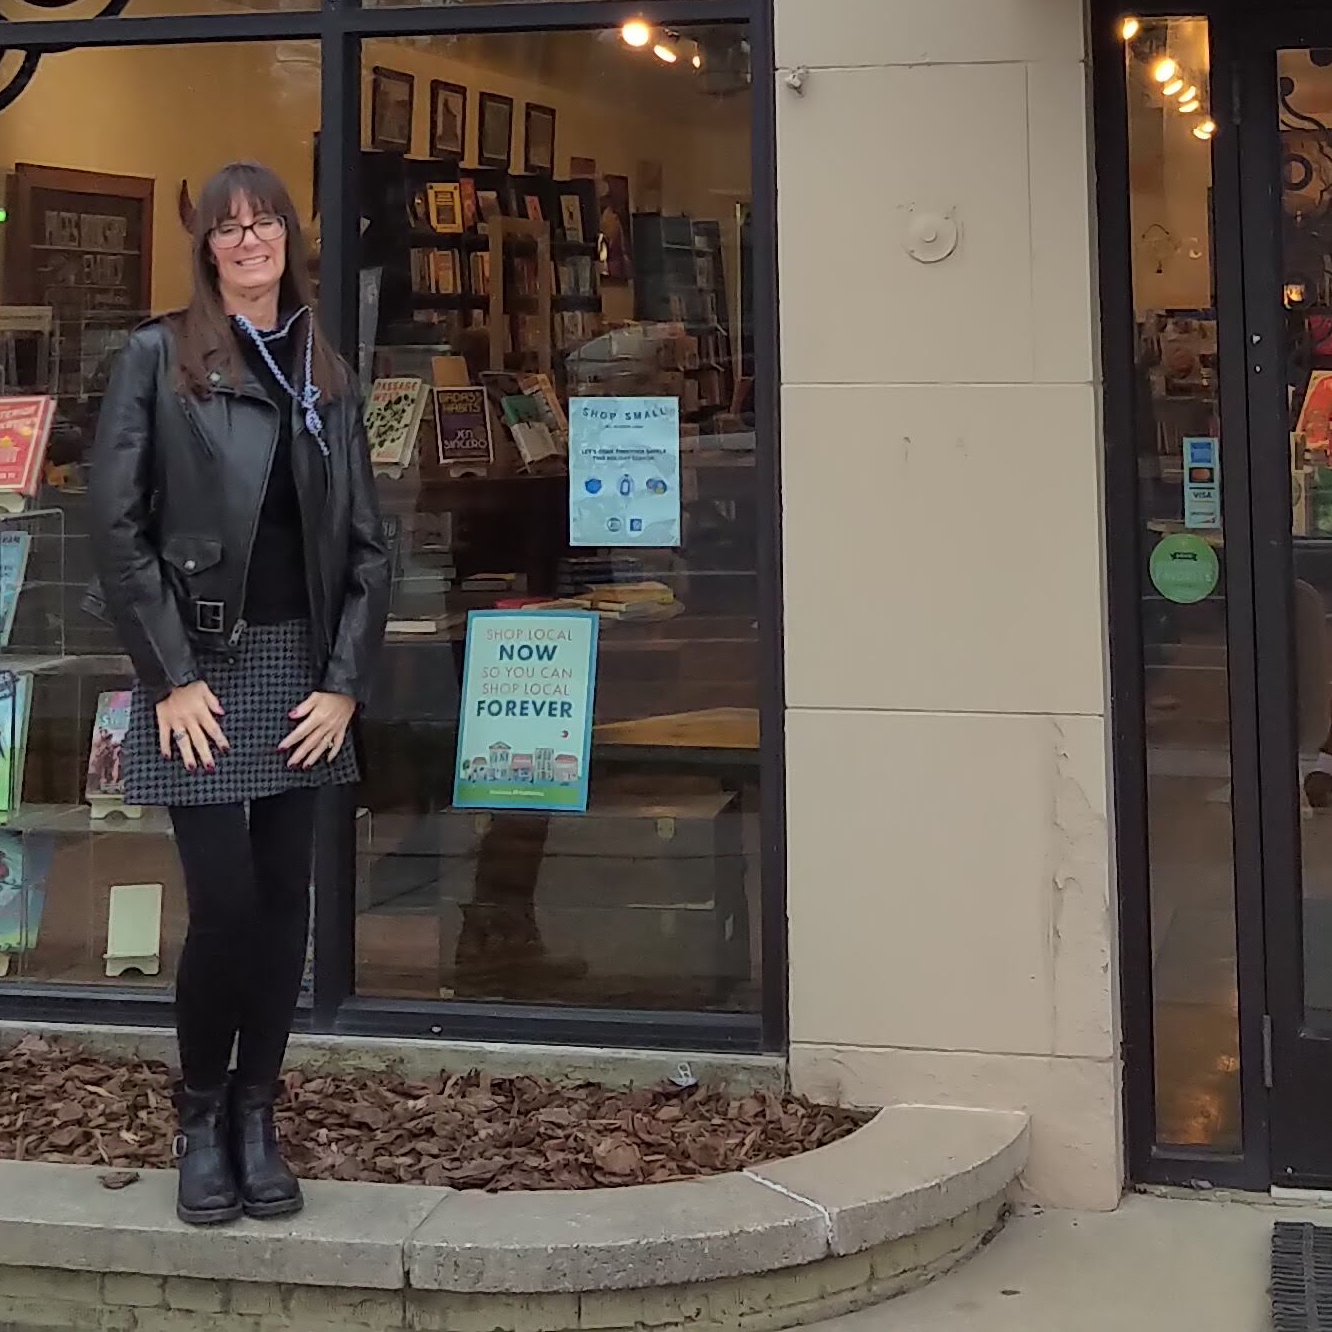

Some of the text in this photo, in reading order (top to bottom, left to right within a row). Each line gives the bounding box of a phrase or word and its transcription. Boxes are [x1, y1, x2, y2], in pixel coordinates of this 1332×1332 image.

[581, 407, 668, 421] SHOP SMALL
[1193, 491, 1213, 499] VISA
[486, 628, 573, 642] SHOP LOCAL
[498, 644, 558, 662] NOW
[481, 666, 573, 679] SO YOU CAN
[482, 682, 570, 696] SHOP LOCAL
[476, 699, 573, 718] FOREVER
